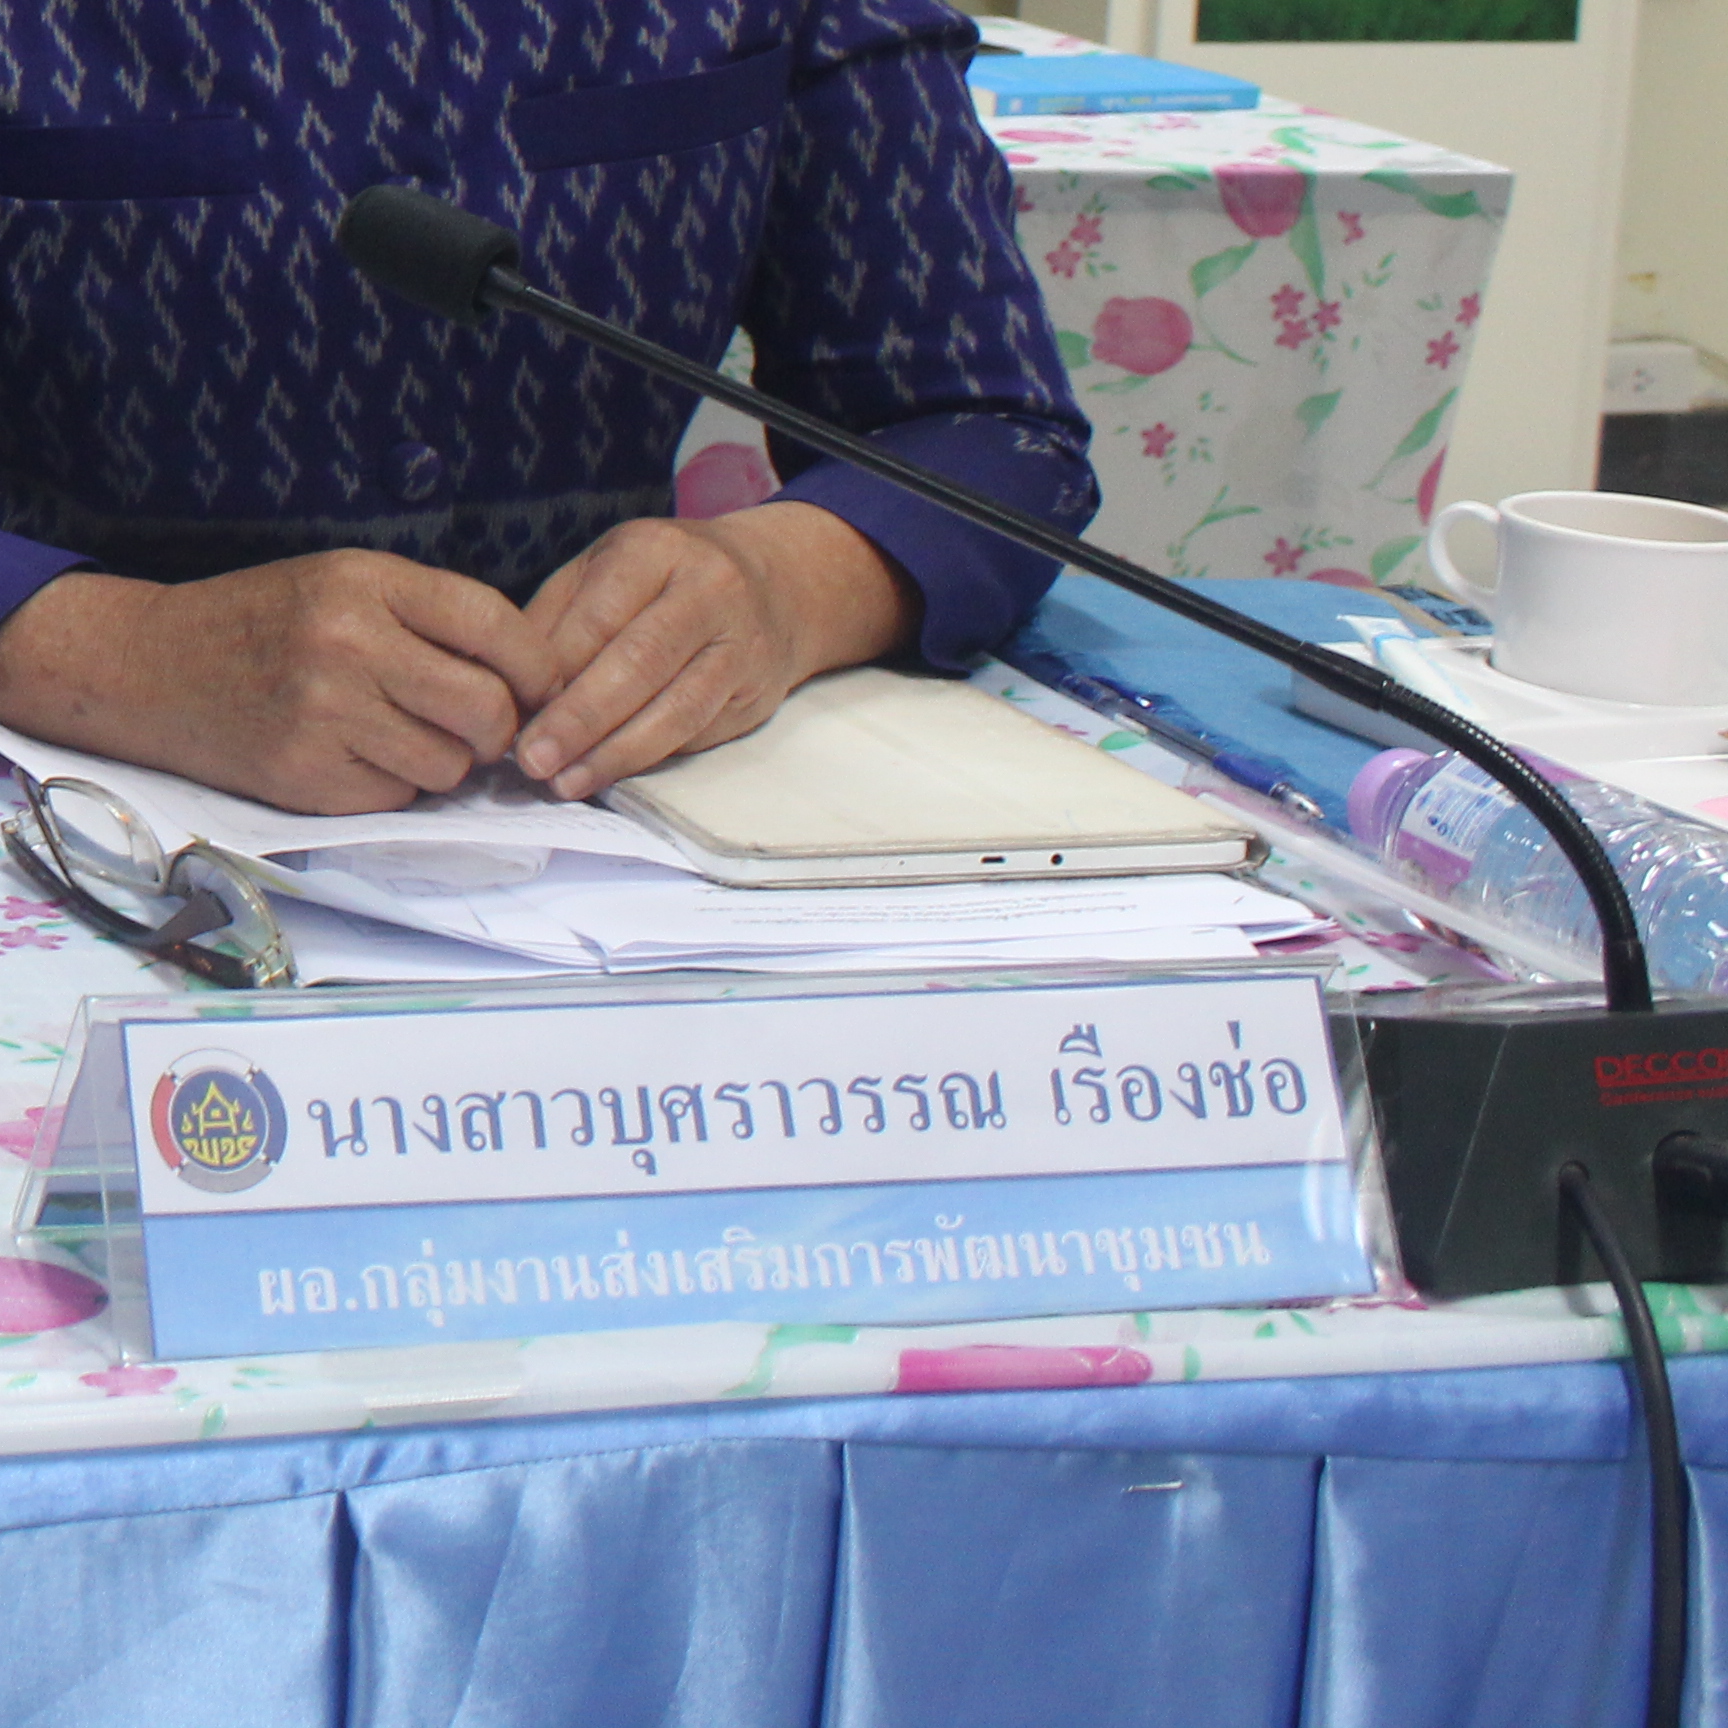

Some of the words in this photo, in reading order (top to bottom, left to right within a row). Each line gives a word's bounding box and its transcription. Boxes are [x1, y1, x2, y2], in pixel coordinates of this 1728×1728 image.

[306, 1069, 1007, 1175] นางสาวบุศราวรรณ
[1050, 1020, 1308, 1125] เรืองช่อ
[1594, 1047, 1728, 1084] DECCO
[258, 1213, 1273, 1328] ผอ.กลุ่มงานส่งเสริมการพัฒนาชุมชน
